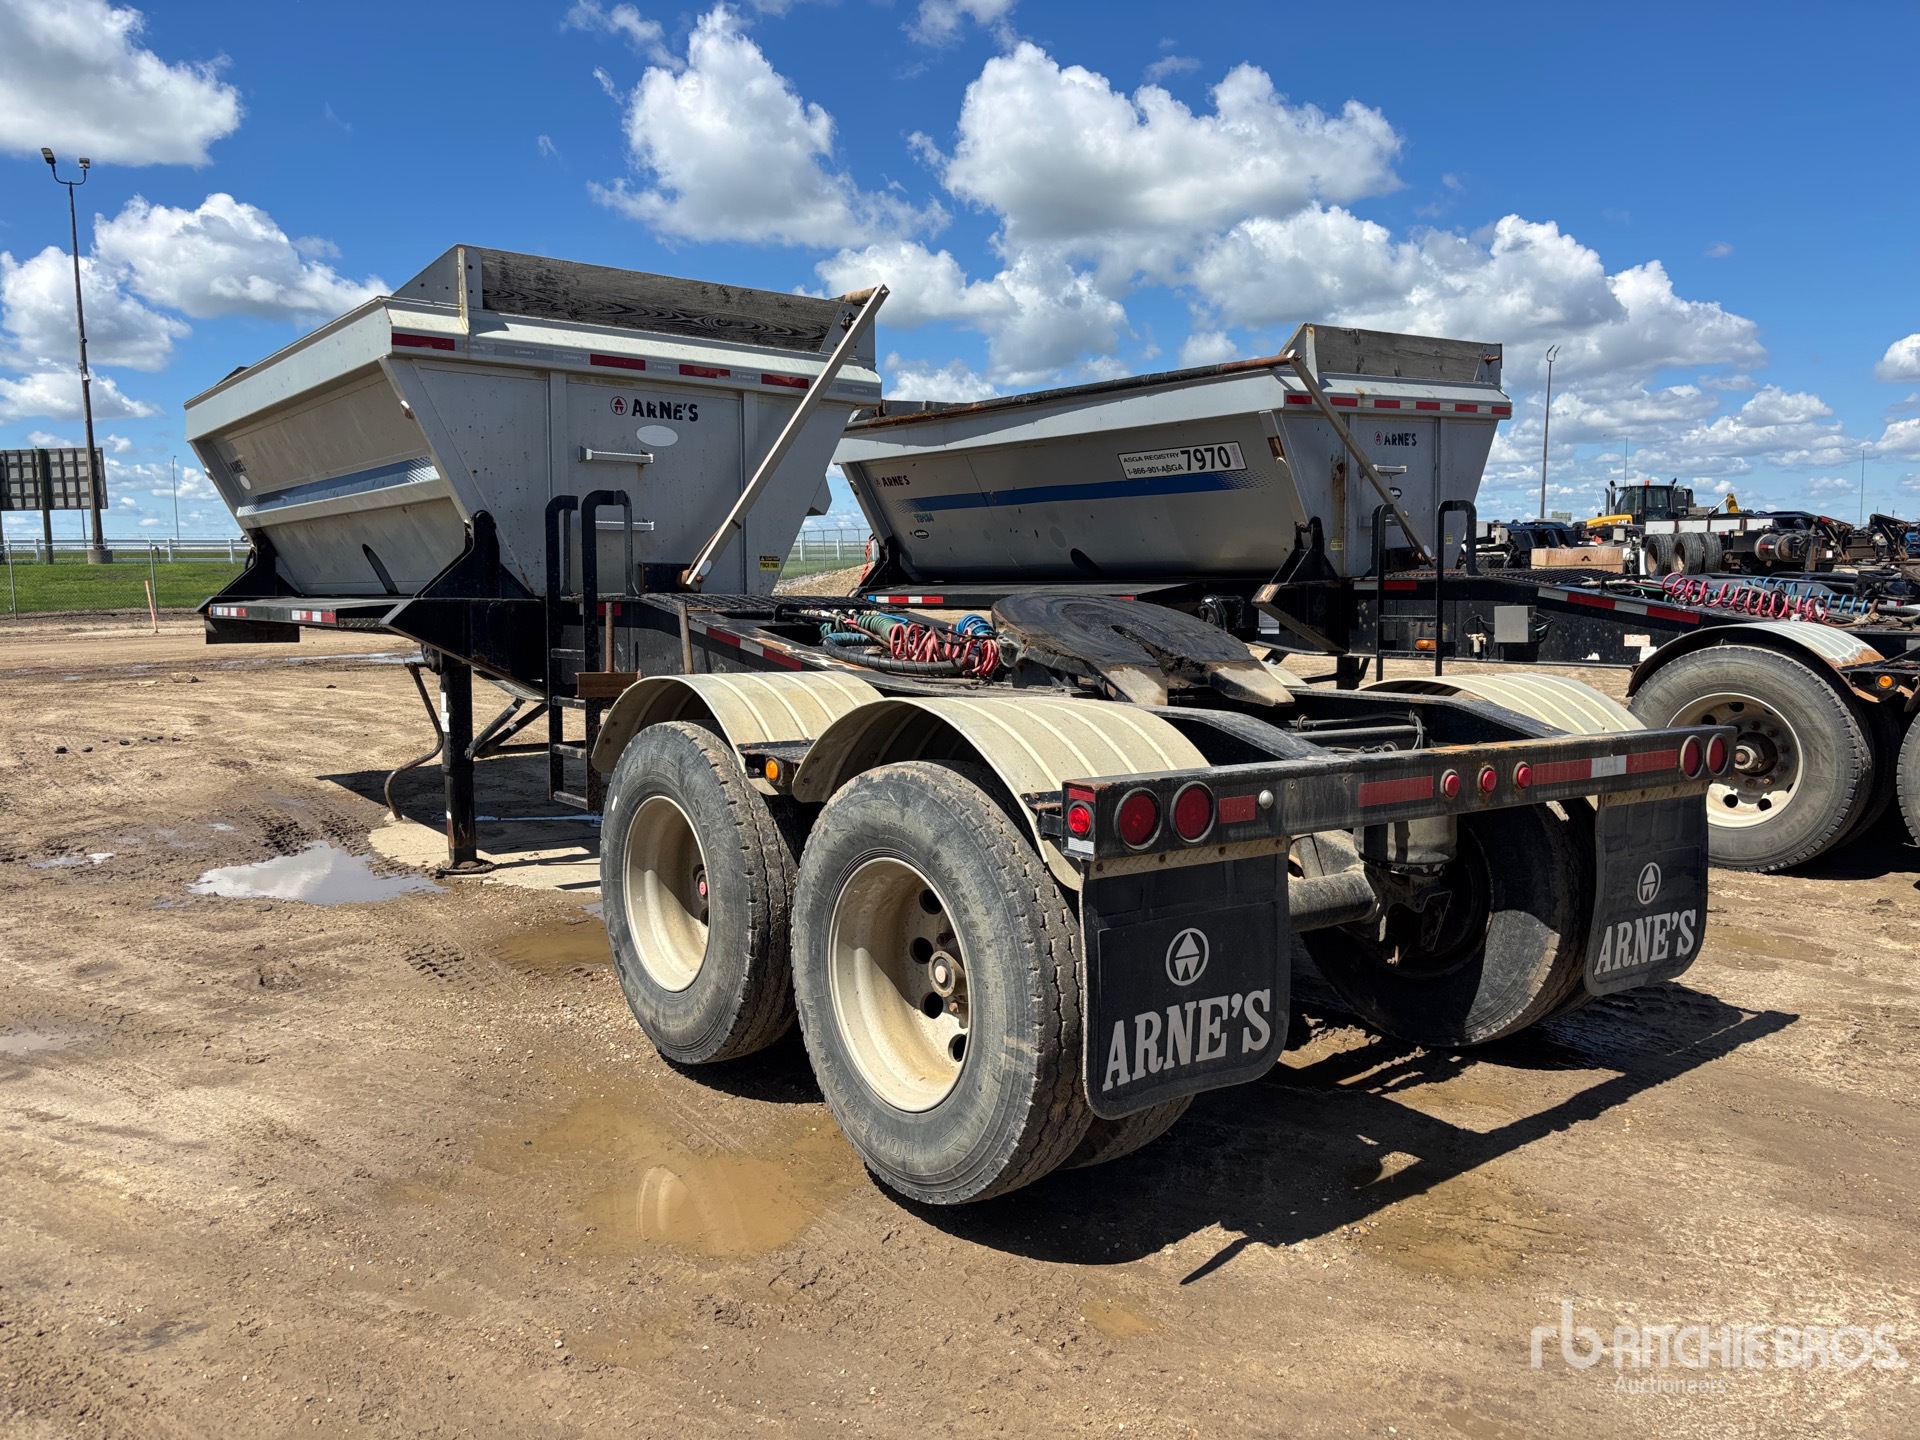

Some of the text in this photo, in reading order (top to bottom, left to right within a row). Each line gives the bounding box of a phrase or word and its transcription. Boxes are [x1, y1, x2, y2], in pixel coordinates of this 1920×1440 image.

[631, 398, 699, 422] ARNE'S
[1384, 432, 1417, 447] ARNE'S
[1123, 452, 1180, 463] ASGA REGISTRY
[1126, 463, 1184, 475] 1-866-901-ASGA
[1180, 445, 1231, 471] 7970
[1594, 908, 1697, 975] ARNE'S
[1102, 988, 1271, 1092] ARNE'S
